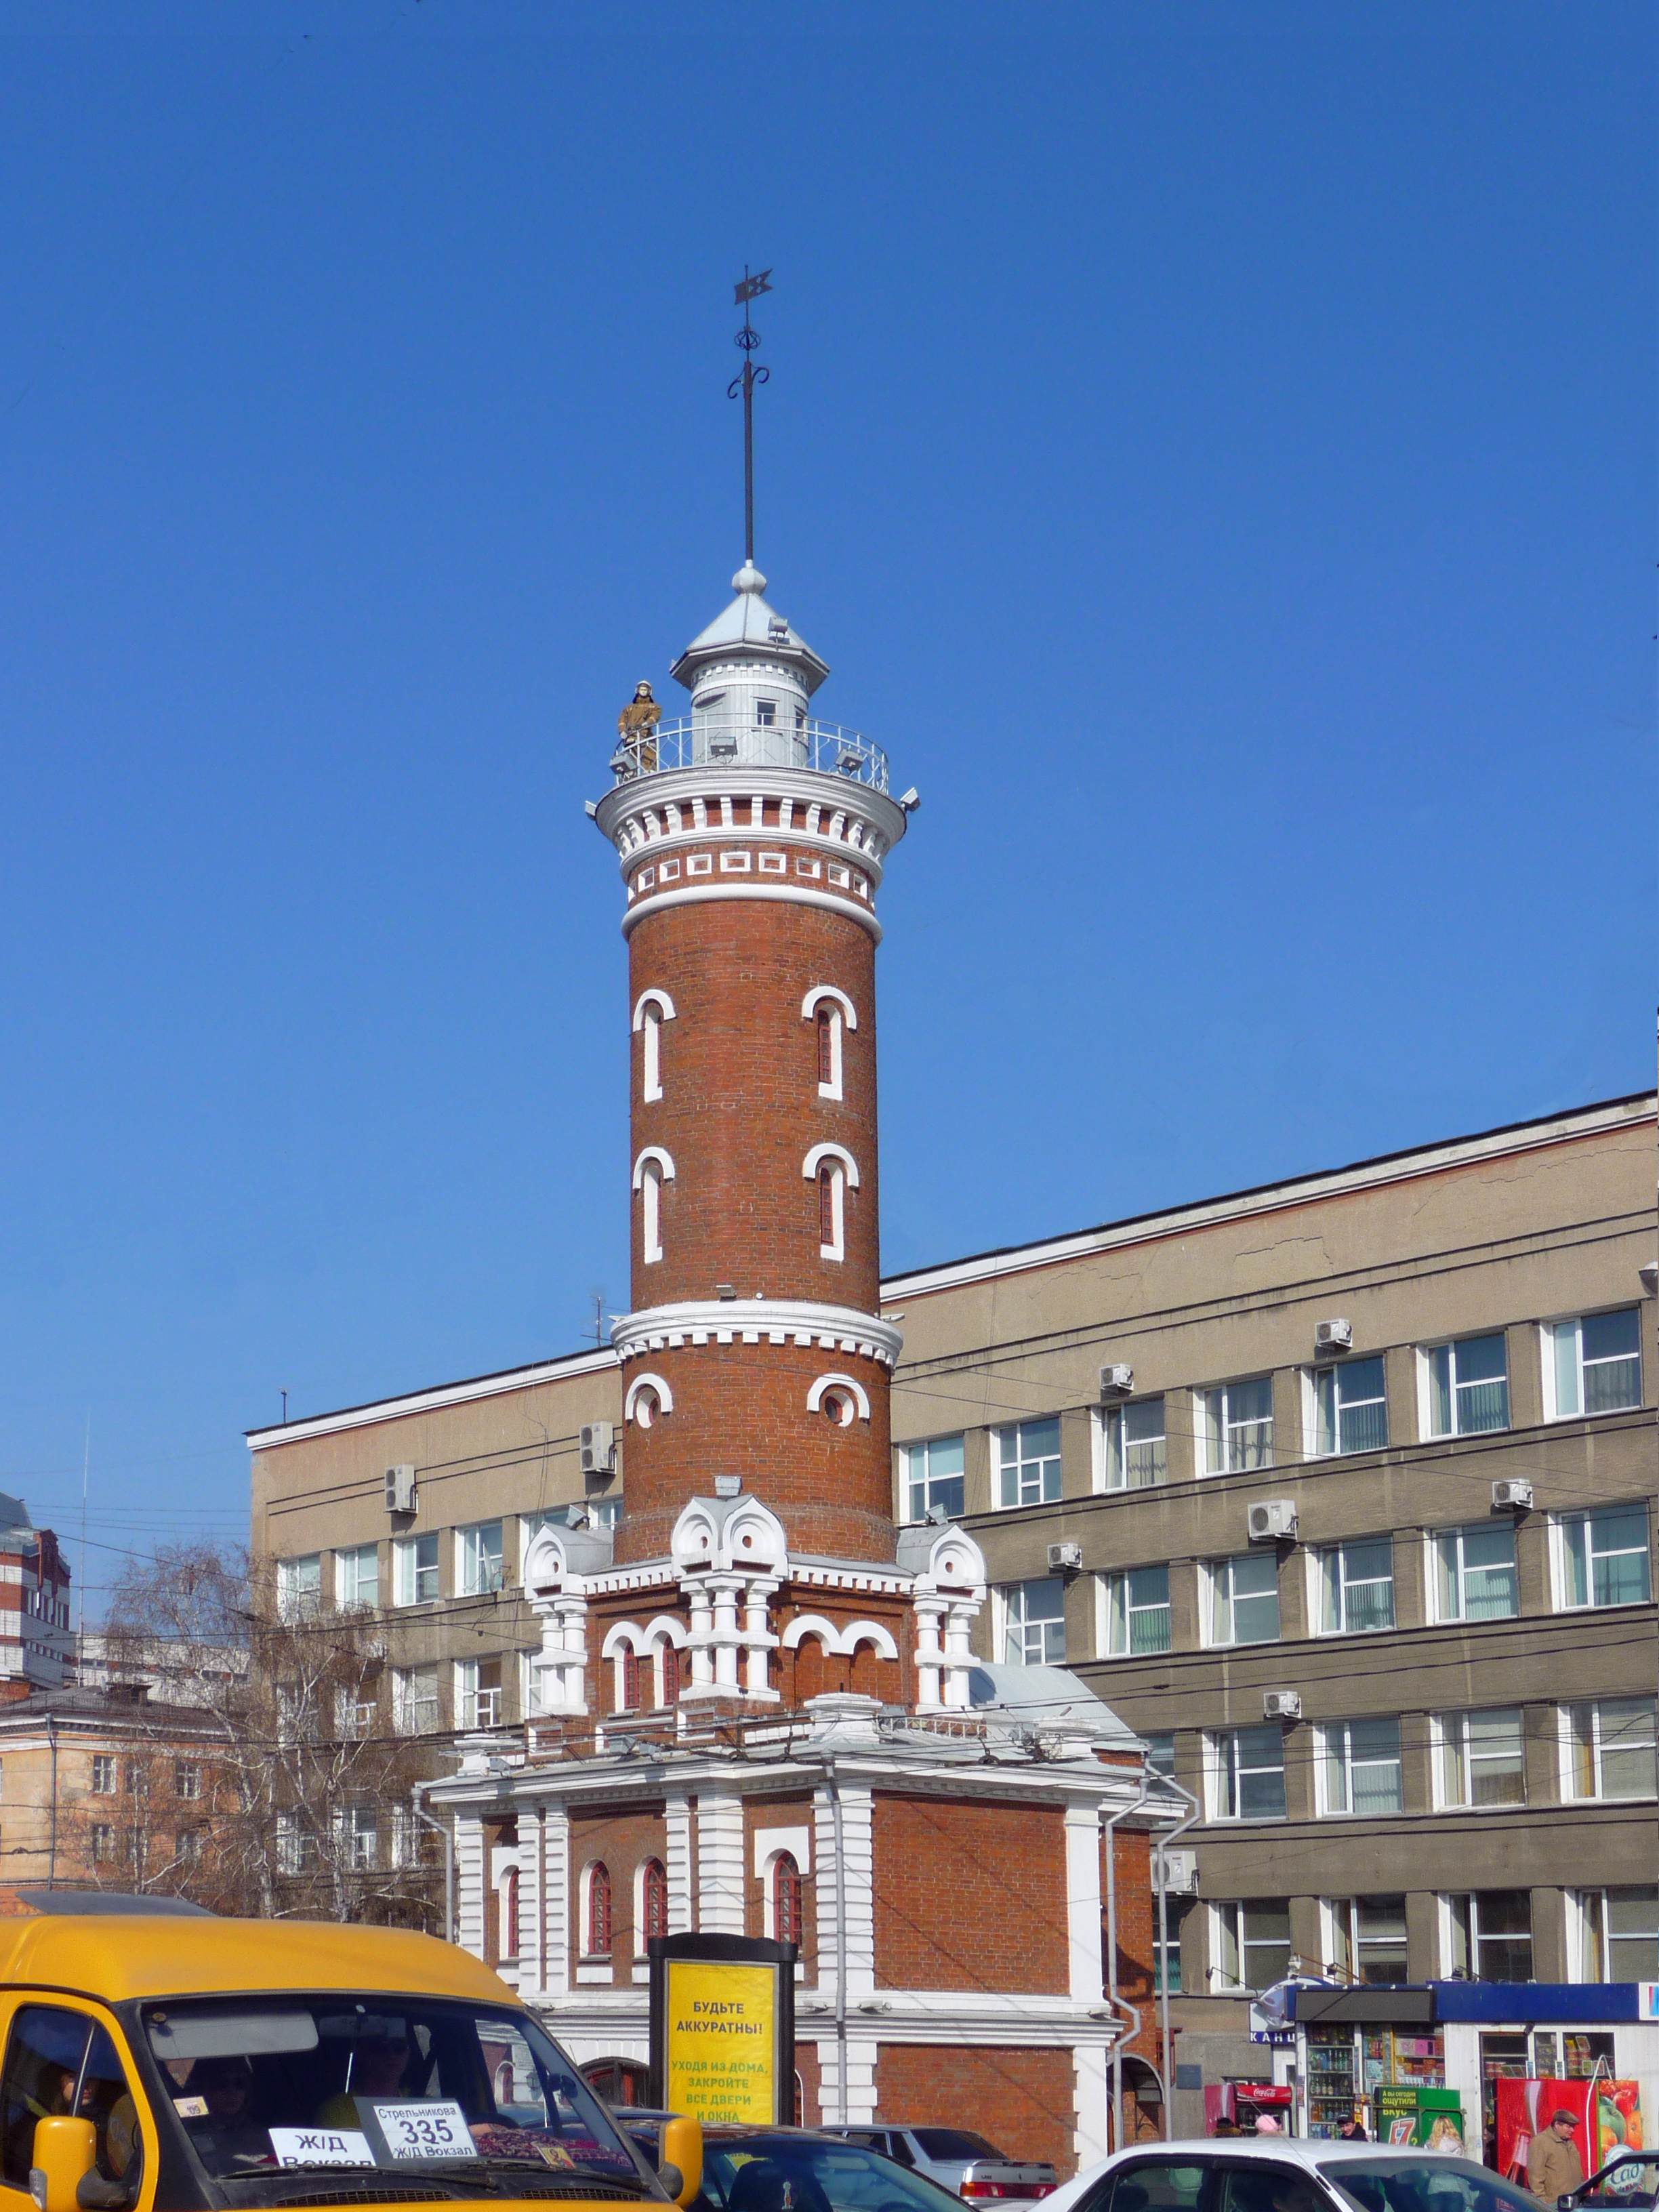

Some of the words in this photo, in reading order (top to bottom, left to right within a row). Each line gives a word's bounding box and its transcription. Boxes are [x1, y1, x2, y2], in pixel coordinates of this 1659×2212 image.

[693, 2001, 744, 2015] БУДЬТЕ
[676, 2020, 763, 2034] АККУРАТНЫ!
[672, 2060, 707, 2072] УХОДЯ
[712, 2062, 726, 2072] ИЗ
[729, 2062, 769, 2074] ДОМА,
[689, 2077, 749, 2089] ЗАКРОЙТЕ
[687, 2093, 708, 2104] ВСЕ
[710, 2095, 751, 2106] ДВЕРИ
[378, 2106, 457, 2121] Стрельникова
[697, 2110, 705, 2121] И
[708, 2111, 739, 2122] ОКНА
[399, 2119, 454, 2144] 335
[295, 2135, 348, 2152] Ж/Д
[395, 2146, 423, 2158] Ж/Д
[425, 2145, 473, 2156] Вокзал
